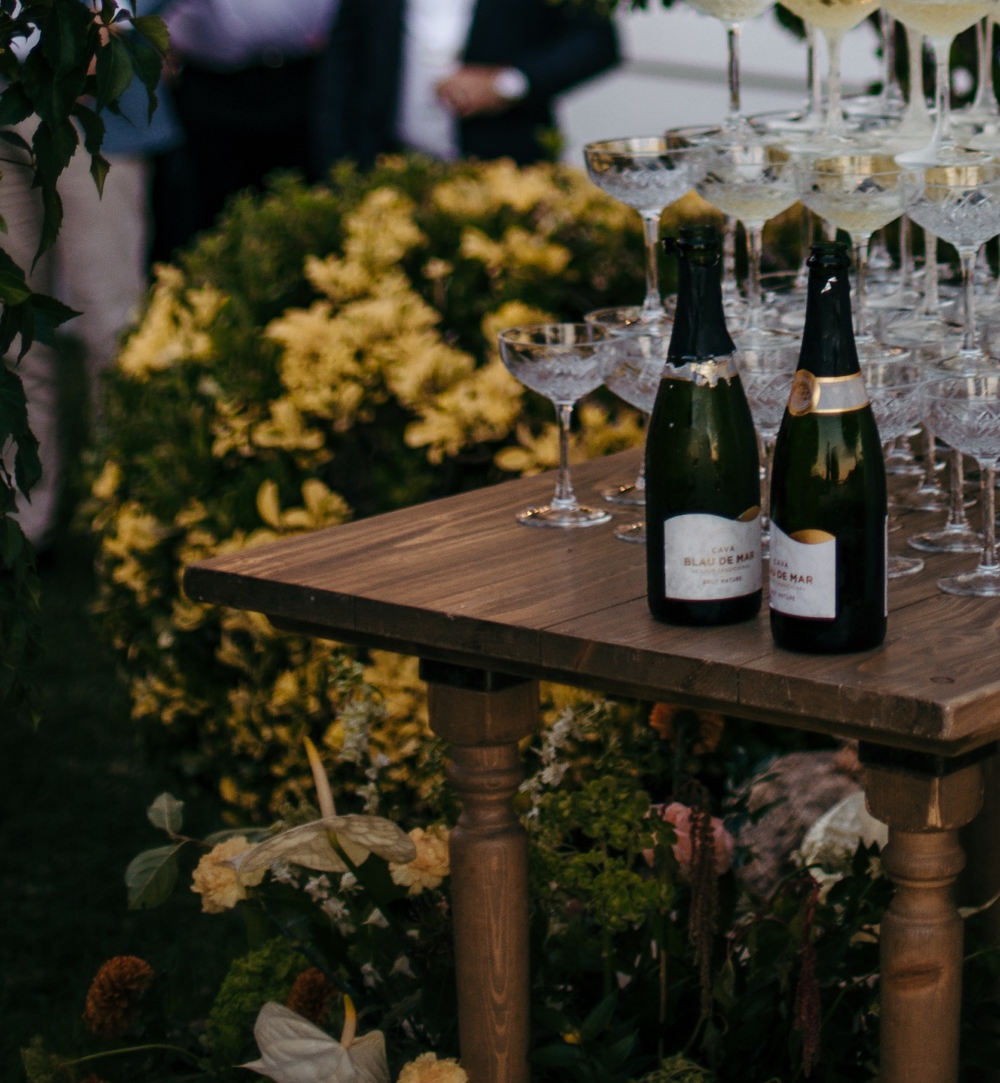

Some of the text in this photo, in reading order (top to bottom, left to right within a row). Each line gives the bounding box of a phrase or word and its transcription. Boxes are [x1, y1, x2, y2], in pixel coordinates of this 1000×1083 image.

[712, 546, 735, 554] CAVA
[684, 551, 755, 566] BLAU DE MAR
[777, 570, 788, 580] DE
[790, 573, 814, 584] MAR
